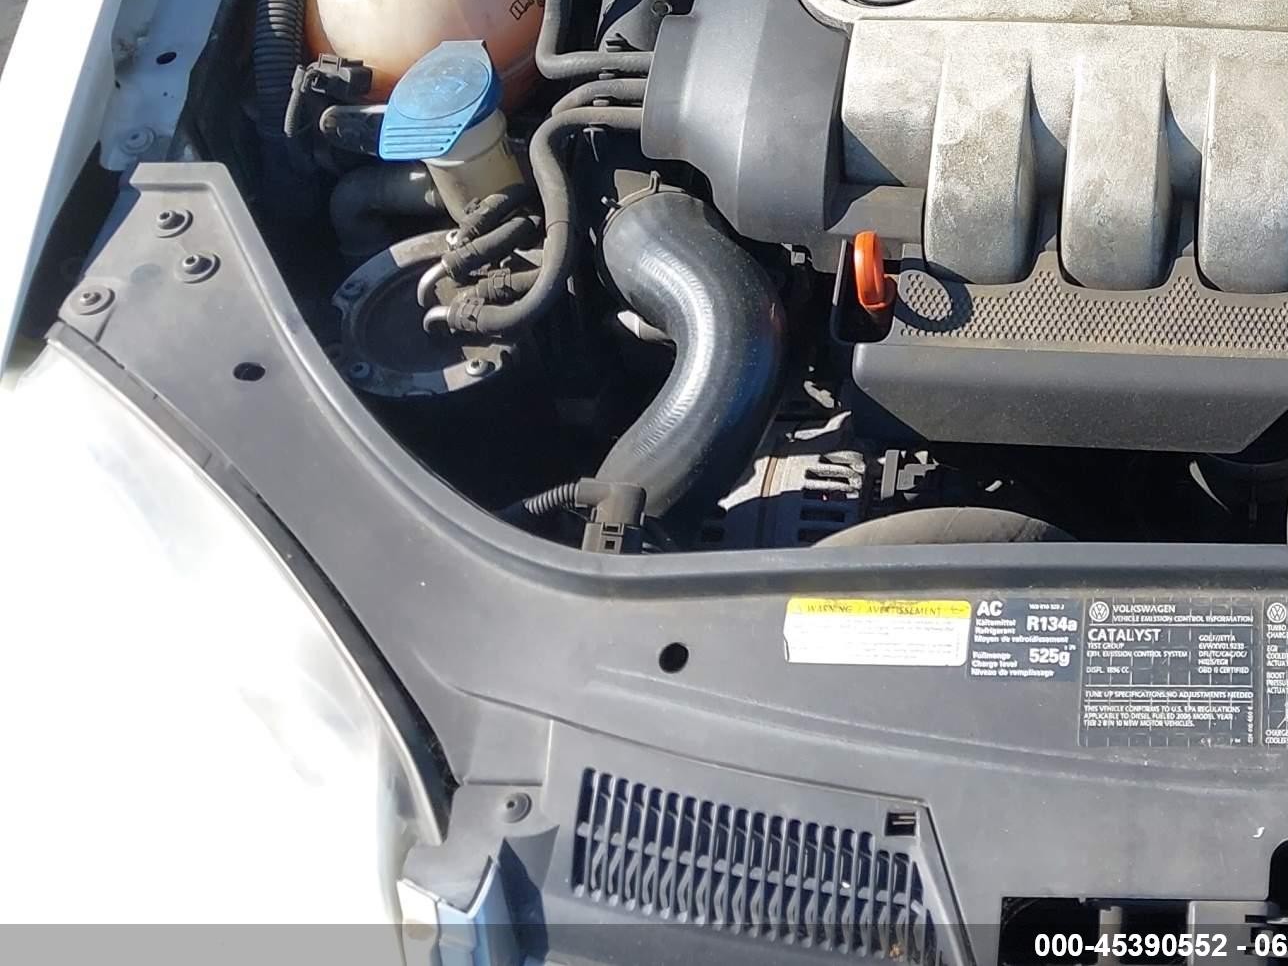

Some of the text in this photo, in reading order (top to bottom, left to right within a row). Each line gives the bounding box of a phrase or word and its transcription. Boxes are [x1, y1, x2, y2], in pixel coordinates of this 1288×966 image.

[976, 600, 1002, 616] AC
[1112, 604, 1175, 613] VOLKSWAGEN
[1026, 615, 1078, 632] R134a
[1087, 629, 1161, 641] CATALYST
[1029, 648, 1070, 667] 525g
[1167, 690, 1178, 698] NO
[1161, 705, 1170, 713] TO
